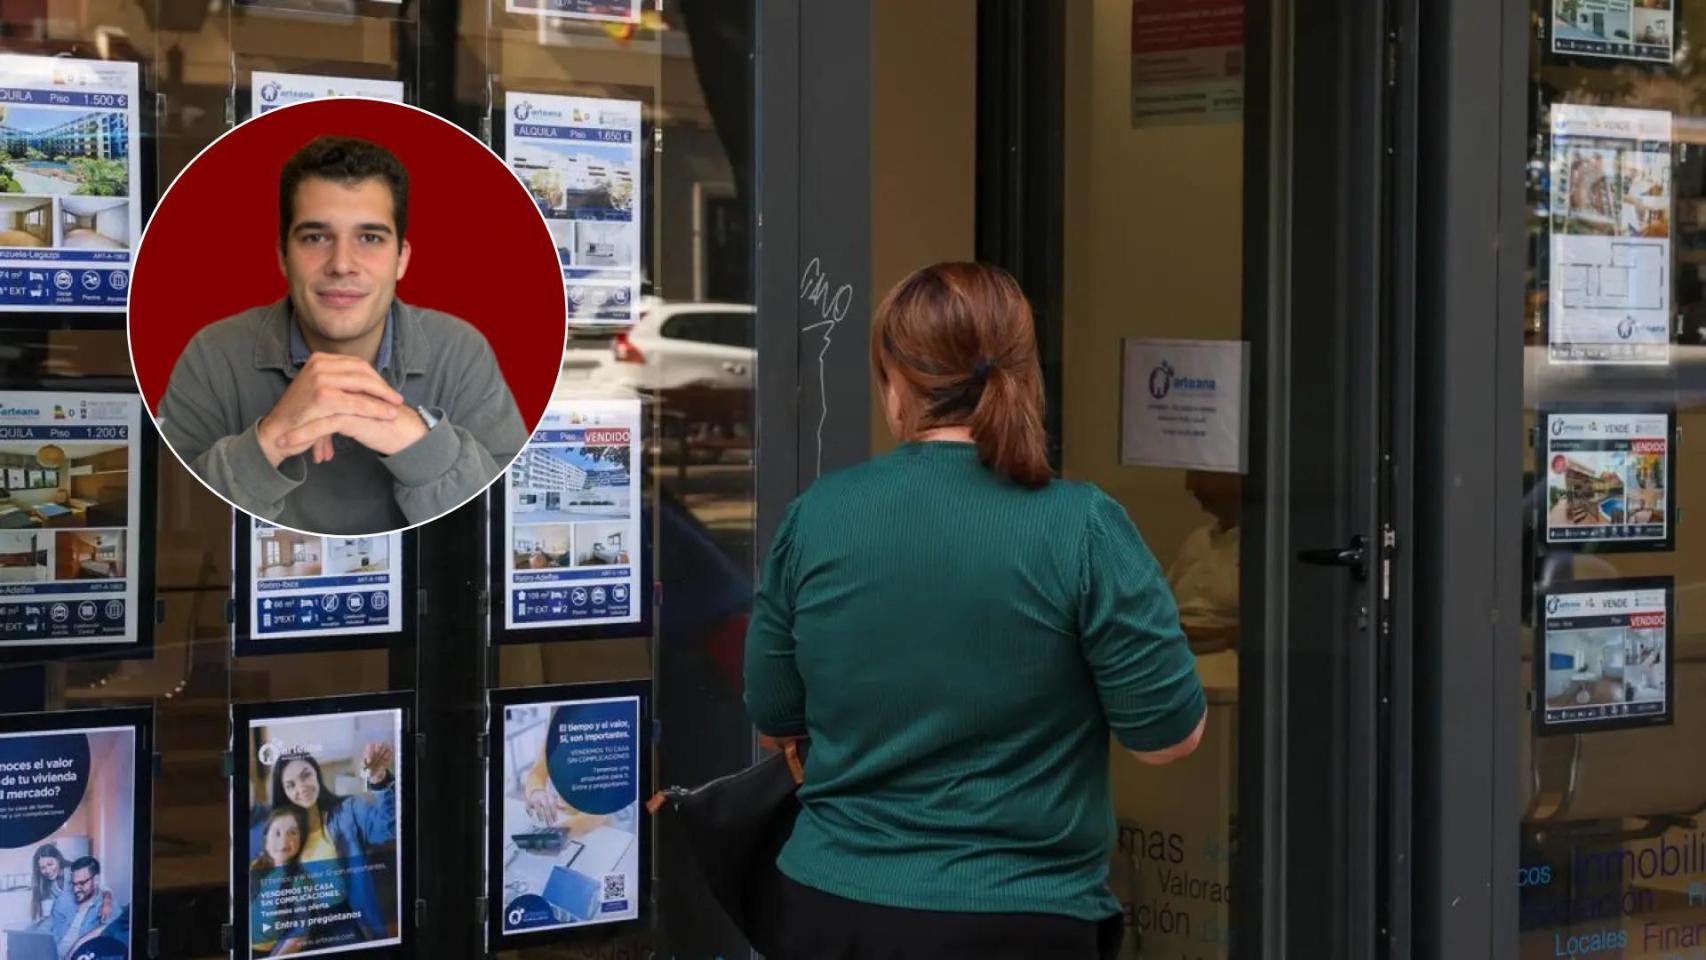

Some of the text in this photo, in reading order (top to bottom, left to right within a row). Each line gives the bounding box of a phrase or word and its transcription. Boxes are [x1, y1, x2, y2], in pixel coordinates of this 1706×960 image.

[50, 94, 70, 103] Piso
[84, 95, 114, 106] 1.500
[118, 96, 126, 106] €
[519, 126, 557, 137] ALQUILA
[50, 429, 71, 438] Piso
[86, 428, 116, 438] 1.200
[119, 428, 127, 438] €
[1604, 424, 1628, 433] VENDE
[584, 432, 630, 442] VENDIDO
[1602, 598, 1628, 608] VENDE
[1631, 615, 1665, 626] VENDIDO
[568, 722, 594, 733] tiempo
[601, 721, 608, 729] el
[34, 759, 44, 770] el
[46, 758, 74, 769] valor
[1, 771, 77, 786] de tu vivienda
[7, 786, 61, 800] mercado?
[1118, 826, 1184, 864] mas
[261, 882, 334, 898] VENDEMOS TU CASA
[261, 898, 274, 906] SIN
[274, 911, 361, 930] Entra y pregúntanos
[1555, 928, 1628, 957] Locales
